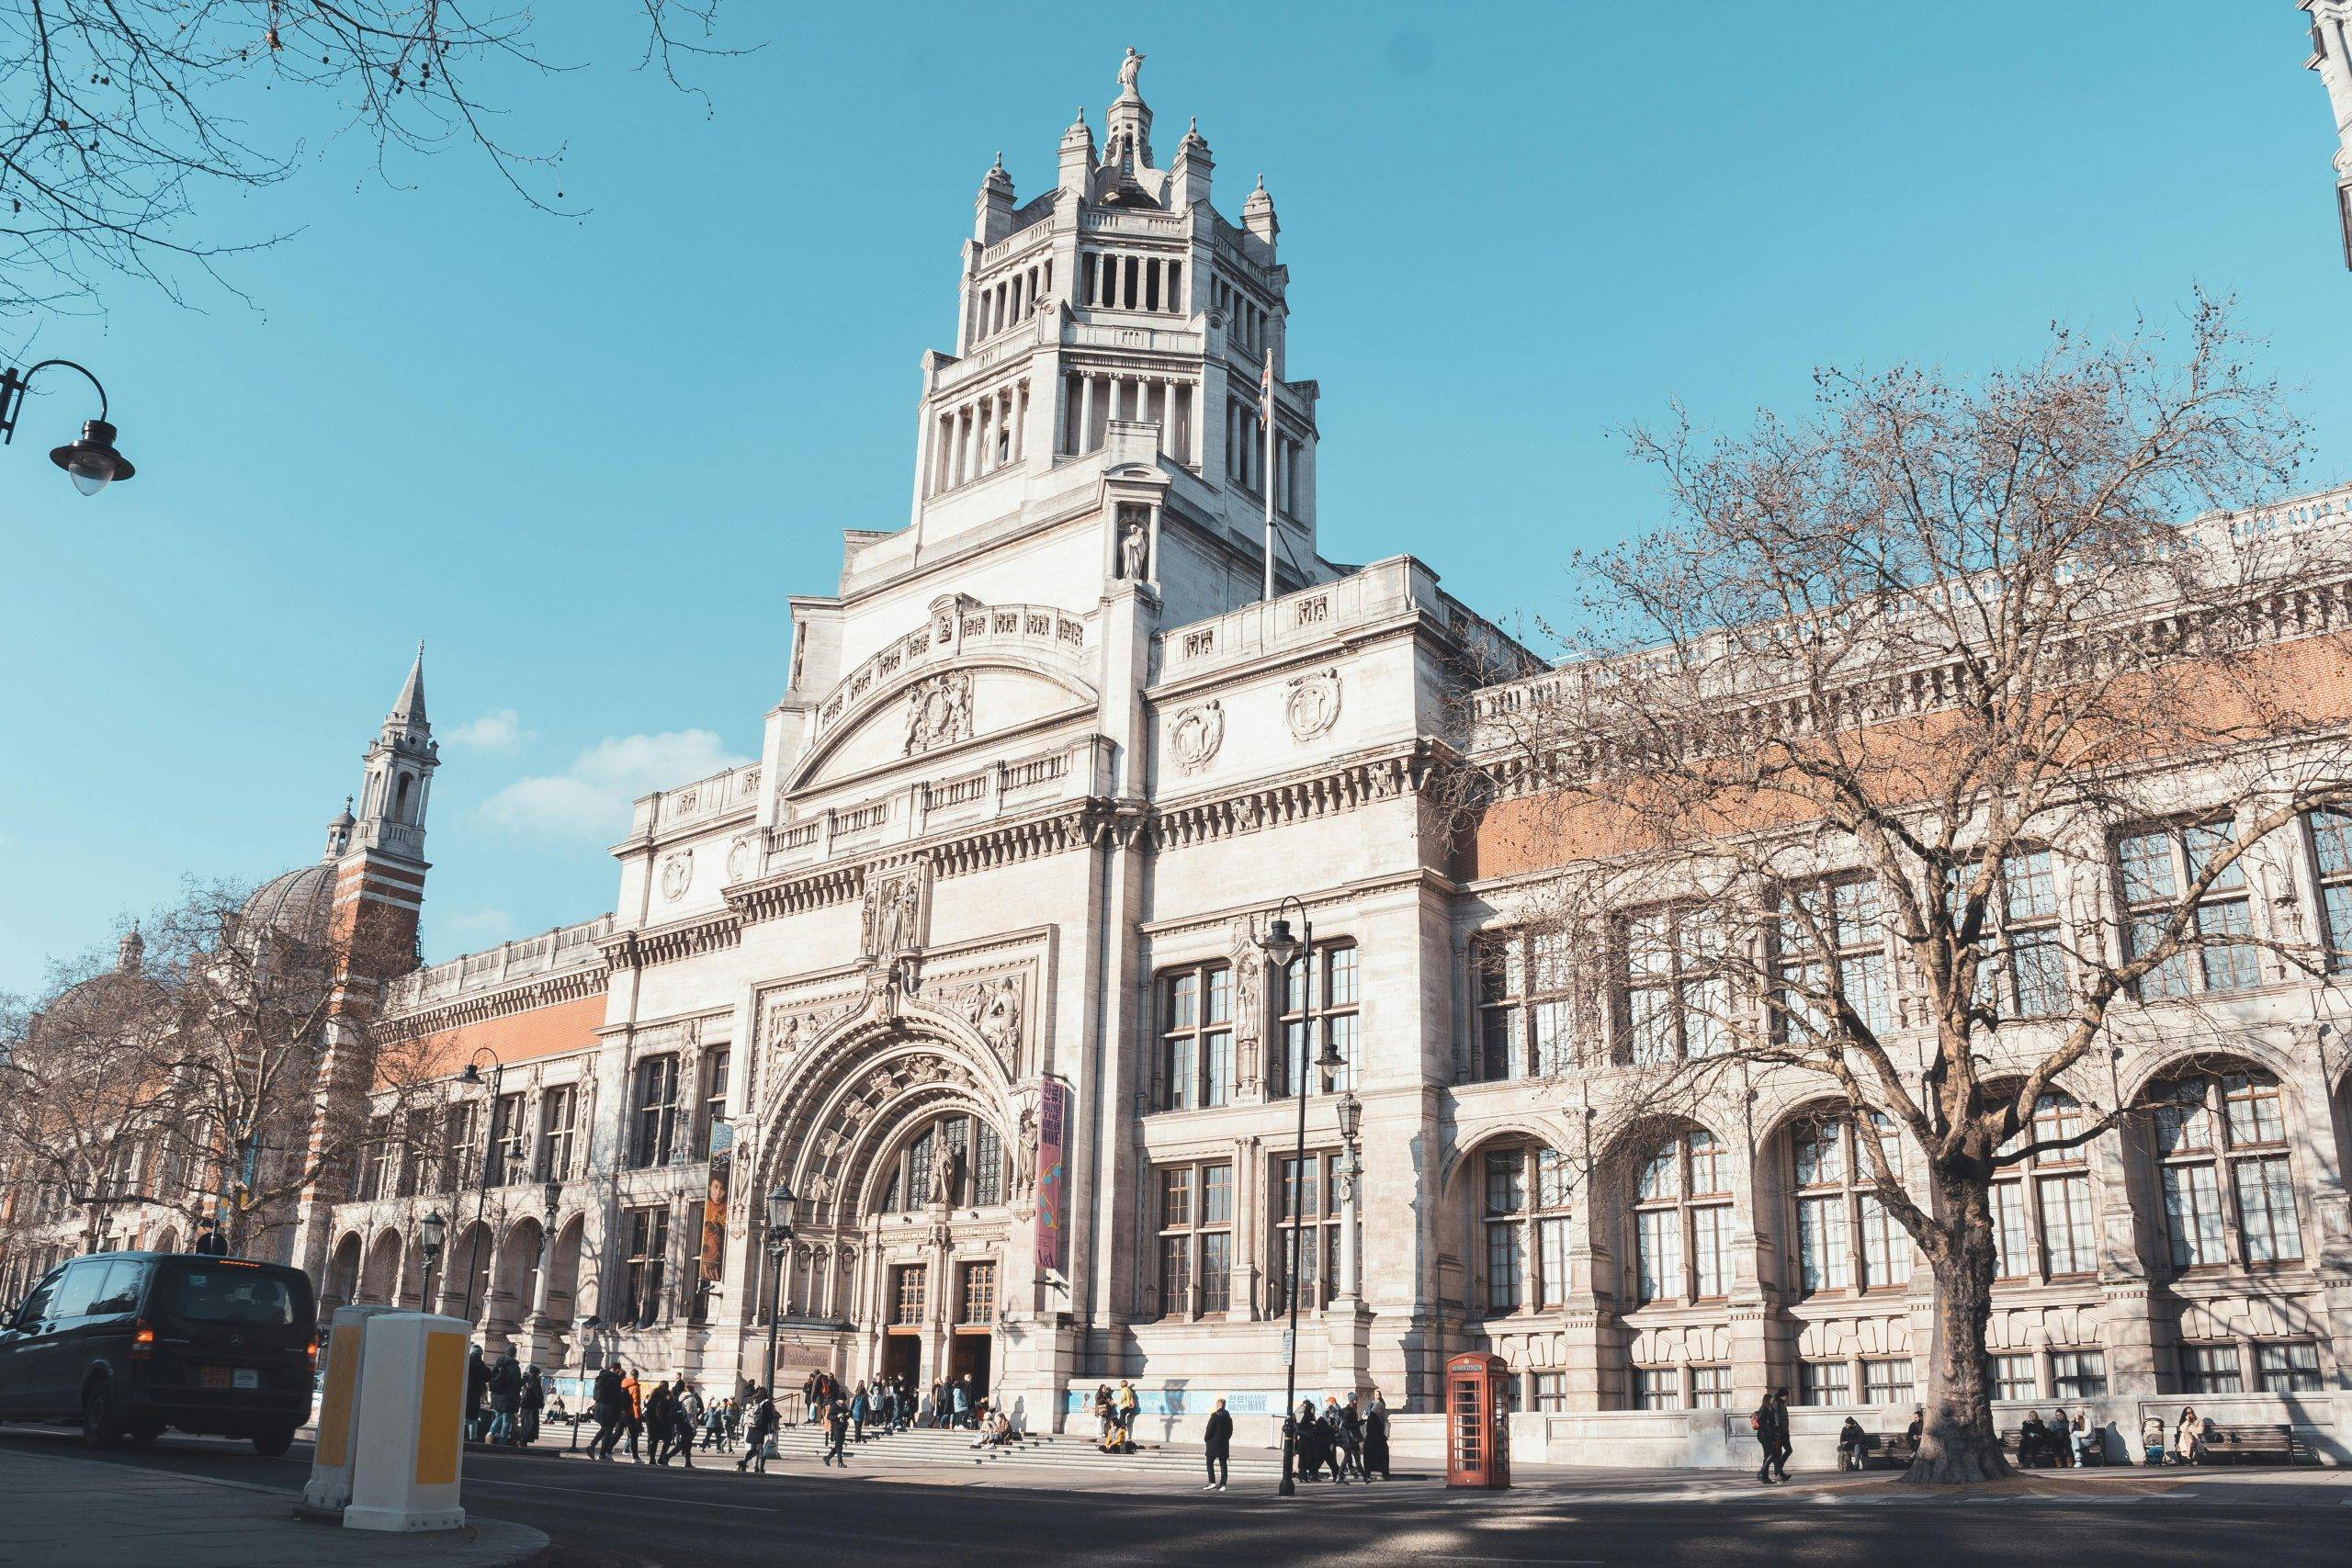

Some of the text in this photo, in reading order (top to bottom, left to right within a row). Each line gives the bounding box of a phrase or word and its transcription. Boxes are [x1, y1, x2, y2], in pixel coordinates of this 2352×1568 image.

[1043, 1111, 1061, 1122] THE
[1043, 1118, 1061, 1132] KOREAN
[1042, 1128, 1061, 1146] WAVE
[711, 1123, 725, 1172] FASHION
[1249, 1399, 1268, 1412] WAVE
